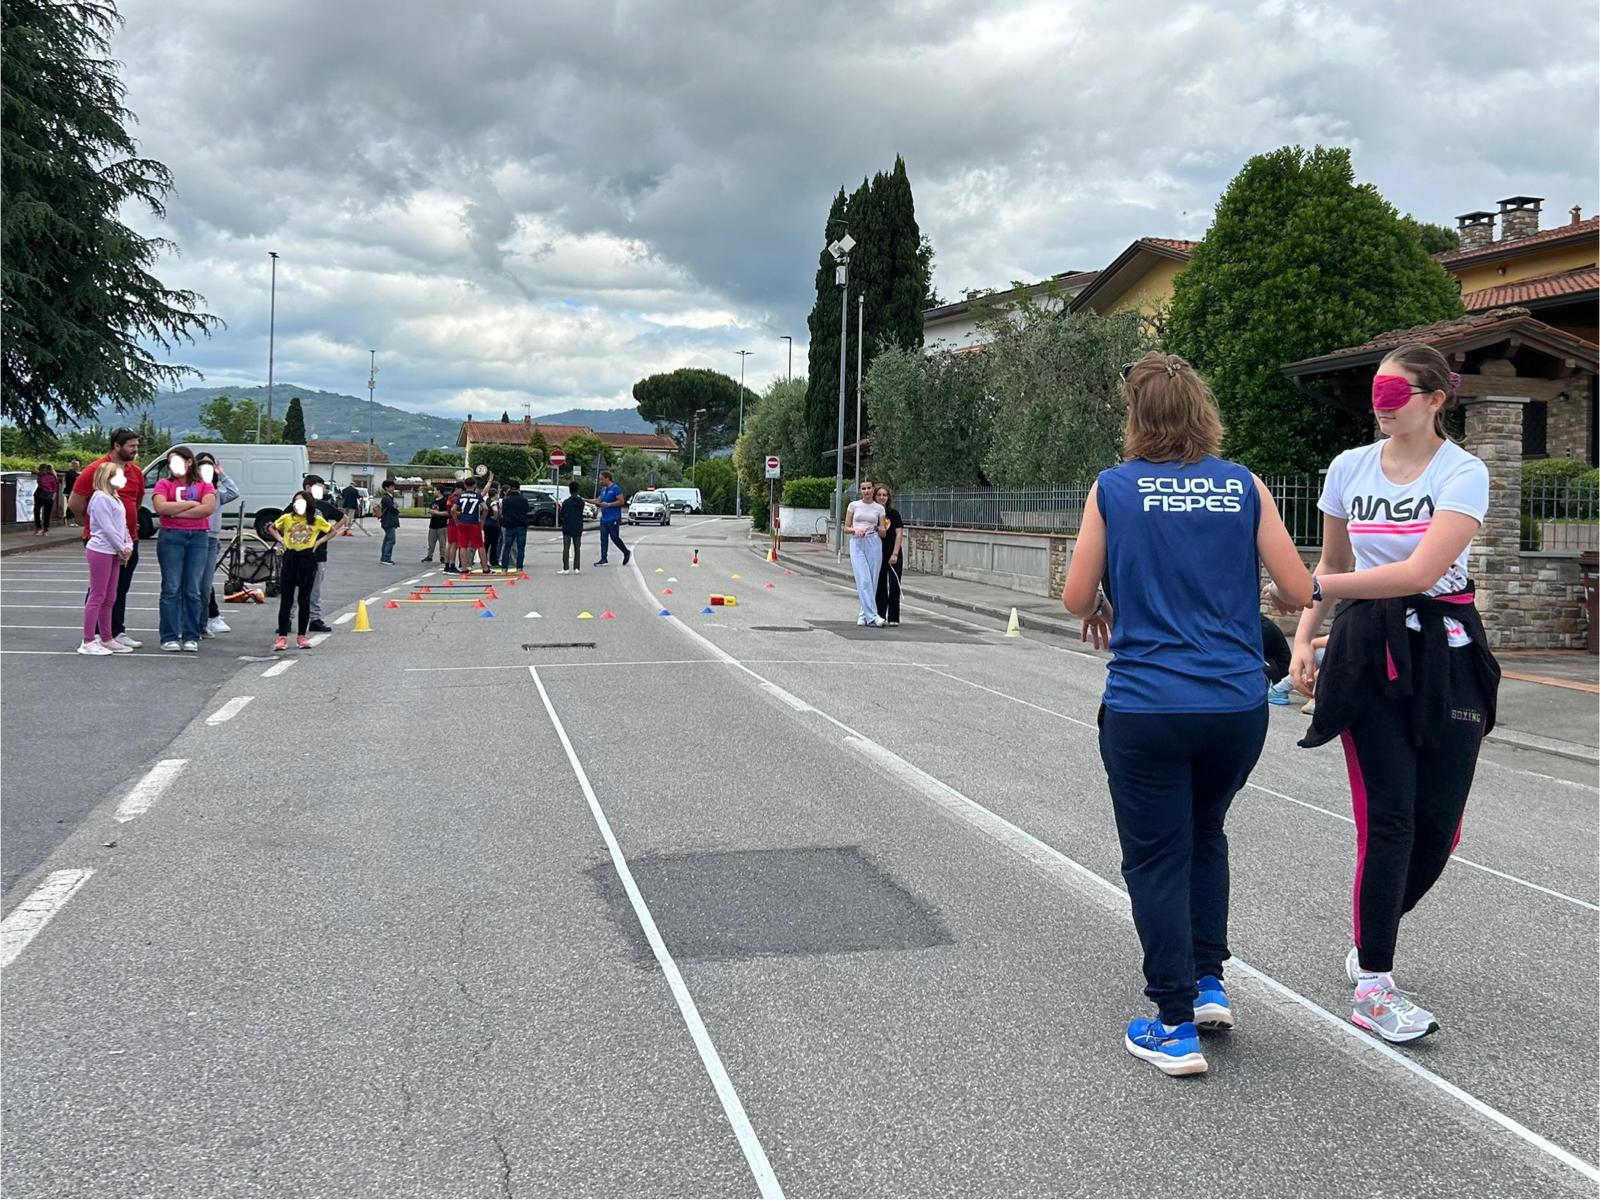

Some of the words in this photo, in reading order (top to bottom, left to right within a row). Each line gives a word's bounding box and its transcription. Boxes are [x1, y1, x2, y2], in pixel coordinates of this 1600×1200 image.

[1137, 478, 1243, 494] SCUOLA
[459, 498, 479, 514] 77
[1143, 495, 1241, 512] FISPES
[1351, 494, 1435, 522] NASA
[1451, 709, 1481, 723] BOXING
